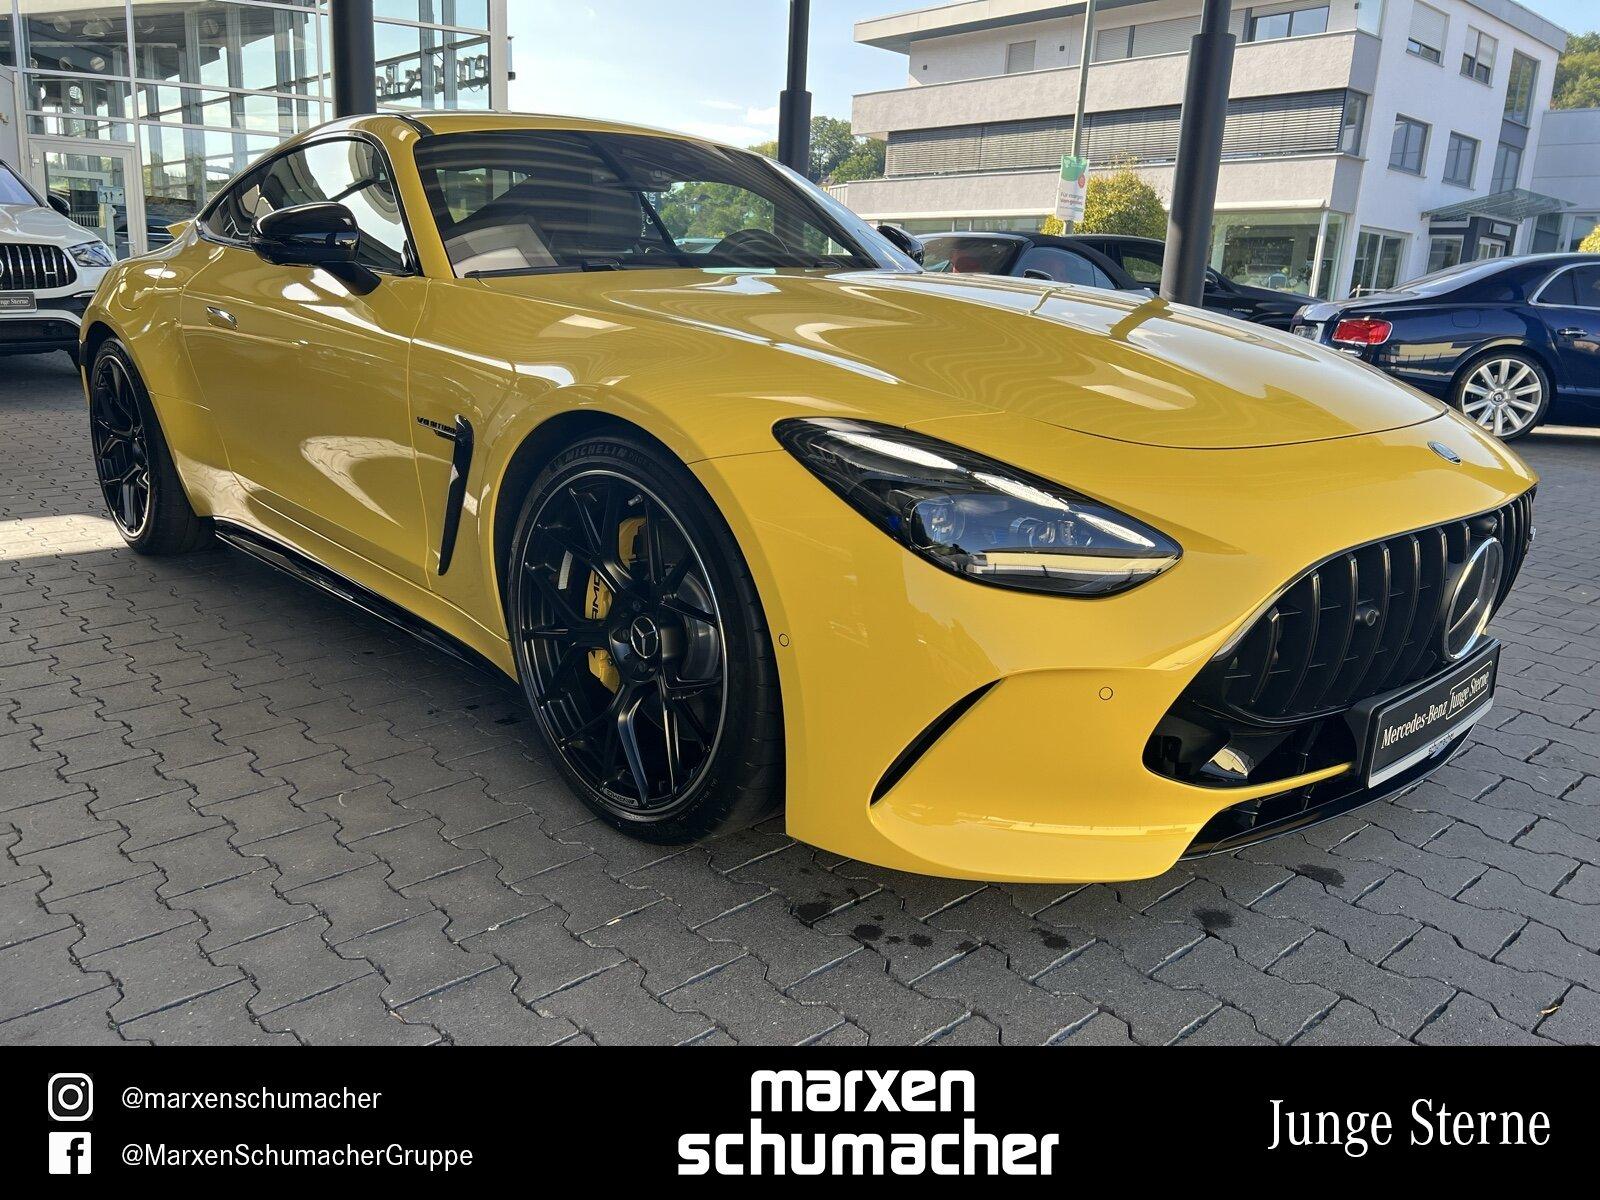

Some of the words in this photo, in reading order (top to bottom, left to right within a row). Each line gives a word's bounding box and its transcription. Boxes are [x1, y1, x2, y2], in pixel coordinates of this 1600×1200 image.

[565, 444, 628, 462] MICHELIN
[1380, 701, 1448, 749] Mercedes-Benz
[1448, 687, 1470, 713] Junge
[1469, 671, 1490, 698] Sterne
